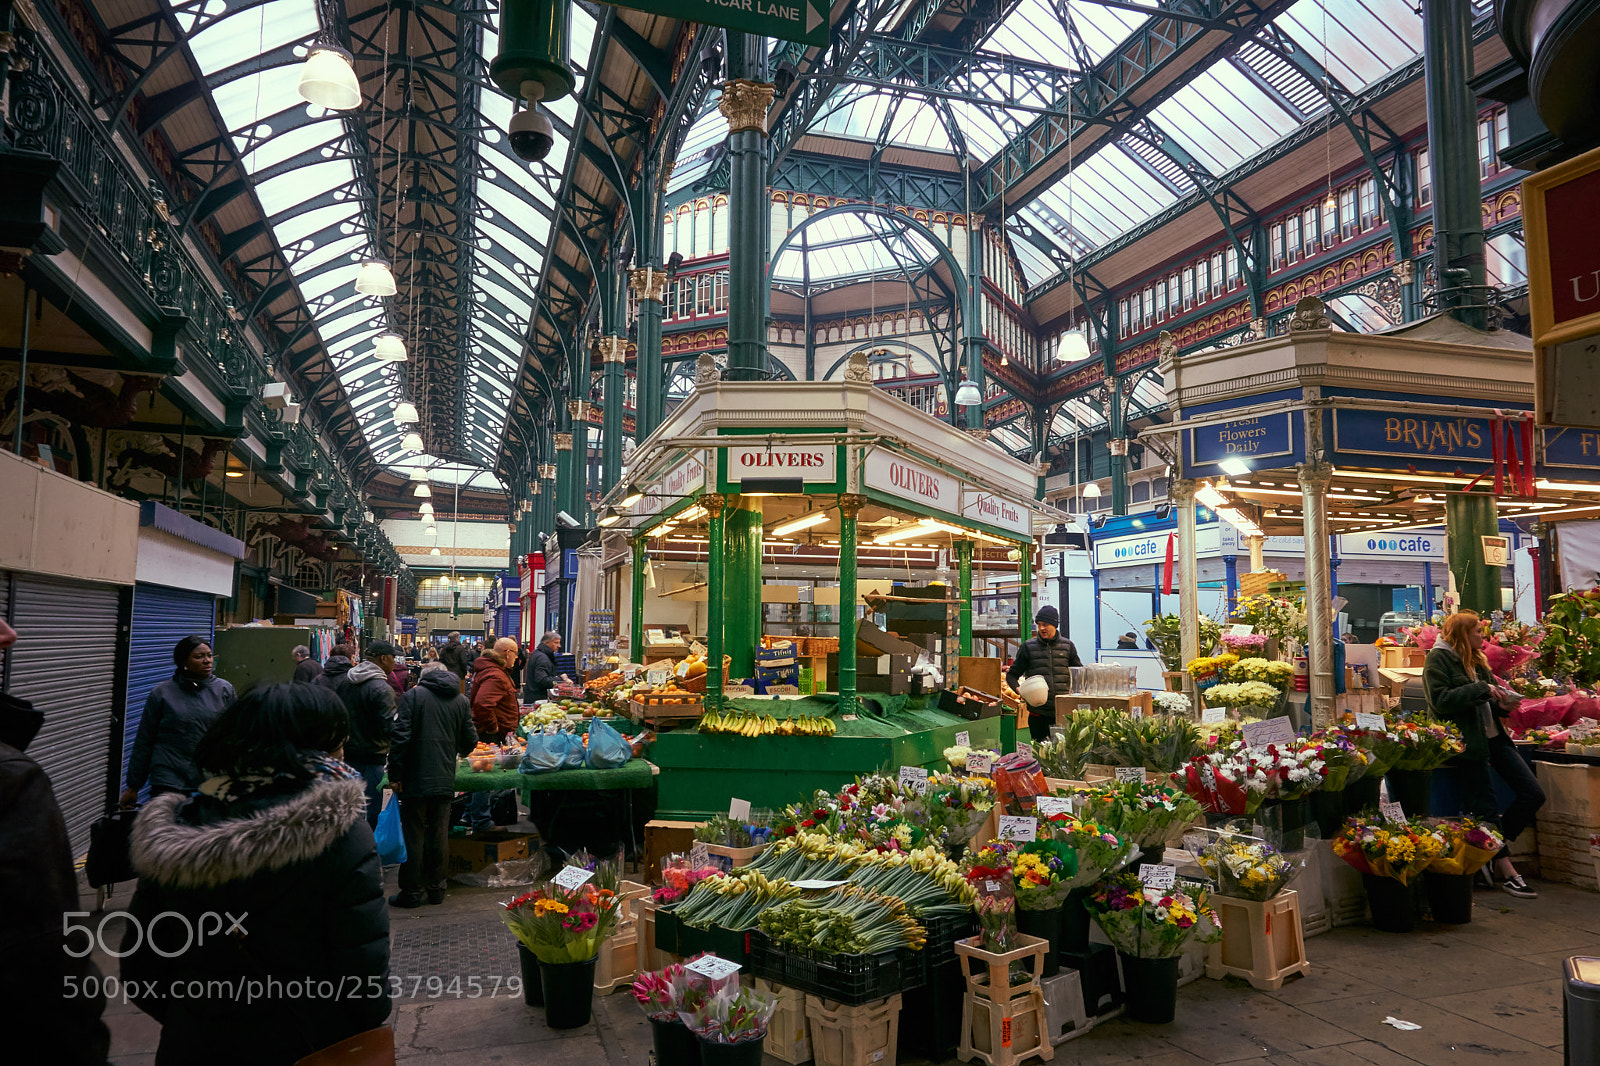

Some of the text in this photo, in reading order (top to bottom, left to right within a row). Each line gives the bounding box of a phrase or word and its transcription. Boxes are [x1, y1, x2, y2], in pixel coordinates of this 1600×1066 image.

[704, 0, 800, 21] CAR LANE
[1219, 427, 1266, 442] Flowers
[1384, 417, 1483, 453] BRIAN'S
[1226, 440, 1260, 454] Daily
[740, 452, 824, 467] OLIVERS
[668, 462, 702, 498] Quality Fruits
[889, 462, 940, 501] OLIVERS
[977, 493, 1019, 523] Quality Fruits
[1134, 539, 1157, 556] cafe
[1399, 536, 1431, 552] cafe
